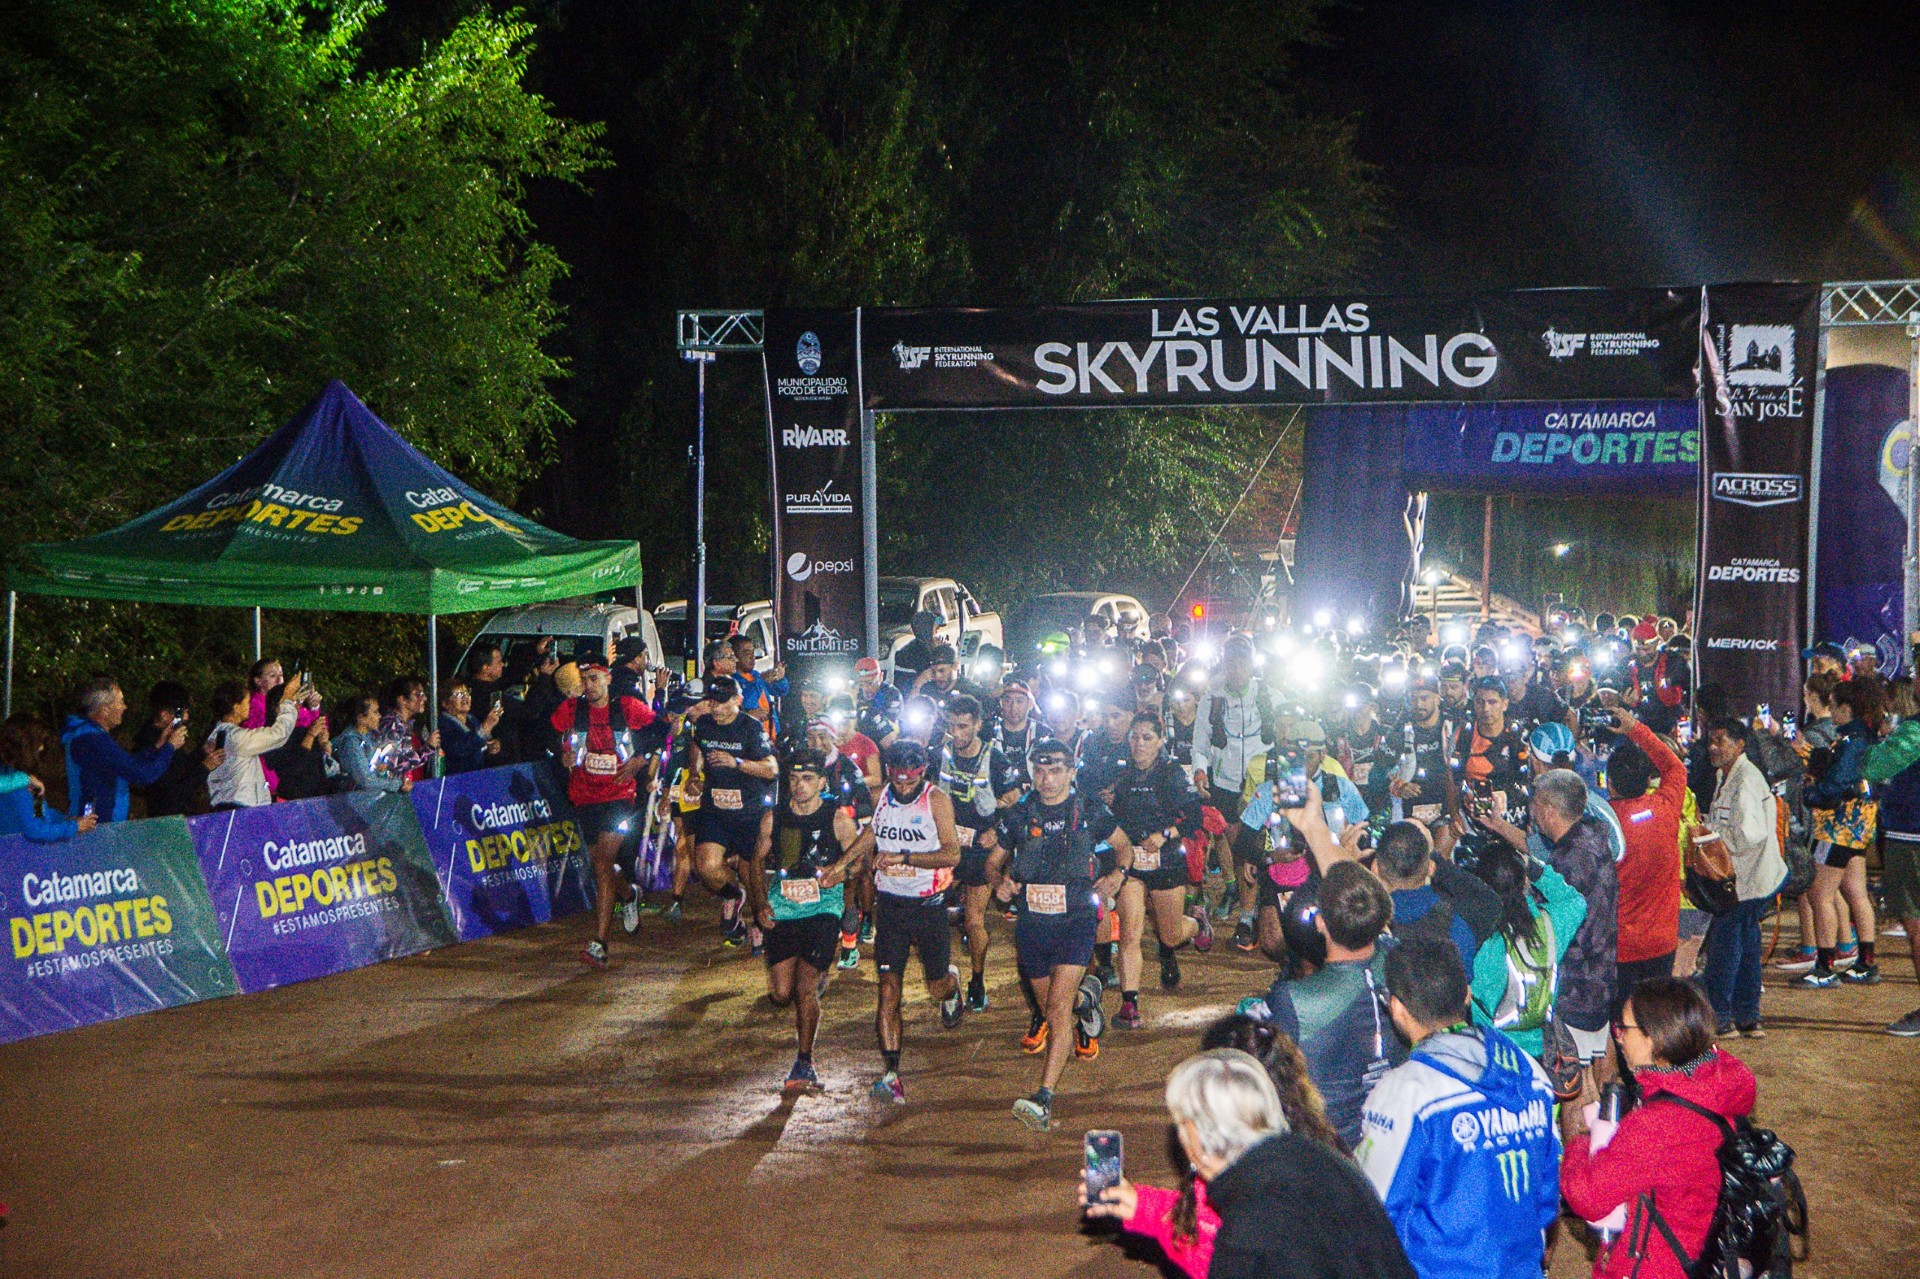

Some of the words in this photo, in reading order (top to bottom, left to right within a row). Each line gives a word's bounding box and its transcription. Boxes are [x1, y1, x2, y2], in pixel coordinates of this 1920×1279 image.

[1151, 306, 1220, 337] LAS
[1229, 302, 1370, 335] VALLAS
[1590, 332, 1646, 341] INTERNATIONAL
[1590, 340, 1660, 349] SKYRUNNING
[935, 352, 994, 361] SKYRUNNING
[1591, 348, 1639, 356] FEDERATION
[1034, 332, 1498, 395] SKYRUNNING
[777, 378, 847, 387] MUNICIPALIDAD
[778, 386, 803, 396] POZO
[804, 386, 816, 395] DE
[817, 385, 849, 395] PIEDRA
[1715, 387, 1754, 417] SAN
[1757, 376, 1805, 422] JOSÉ
[1544, 411, 1656, 430] CATAMARCA
[1491, 430, 1701, 466] DEPORTES
[1717, 478, 1797, 493] ACROSS
[786, 493, 822, 502] PURA
[823, 493, 852, 502] VIDA
[159, 499, 364, 536] DEPORTES
[814, 558, 854, 575] pepsi
[1731, 557, 1781, 567] CATAMARCA
[1708, 566, 1800, 583] DEPORTES
[787, 637, 809, 651] SIN
[809, 637, 859, 651] LIMITES
[1707, 637, 1778, 651] MERVICK
[471, 799, 553, 831] Catamarca
[875, 826, 926, 842] LEGION
[263, 832, 366, 871] Catamarca
[465, 820, 582, 873] DEPORTES
[23, 867, 139, 907] Catamarca
[255, 857, 398, 918] DEPORTES
[1032, 891, 1061, 905] 1158
[273, 896, 400, 936] #ESTAMOSPRESENTES
[9, 894, 173, 959] DEPORTES
[27, 938, 174, 978] #ESTAMOSPRESENTES
[1477, 1099, 1549, 1139] YAMAHA
